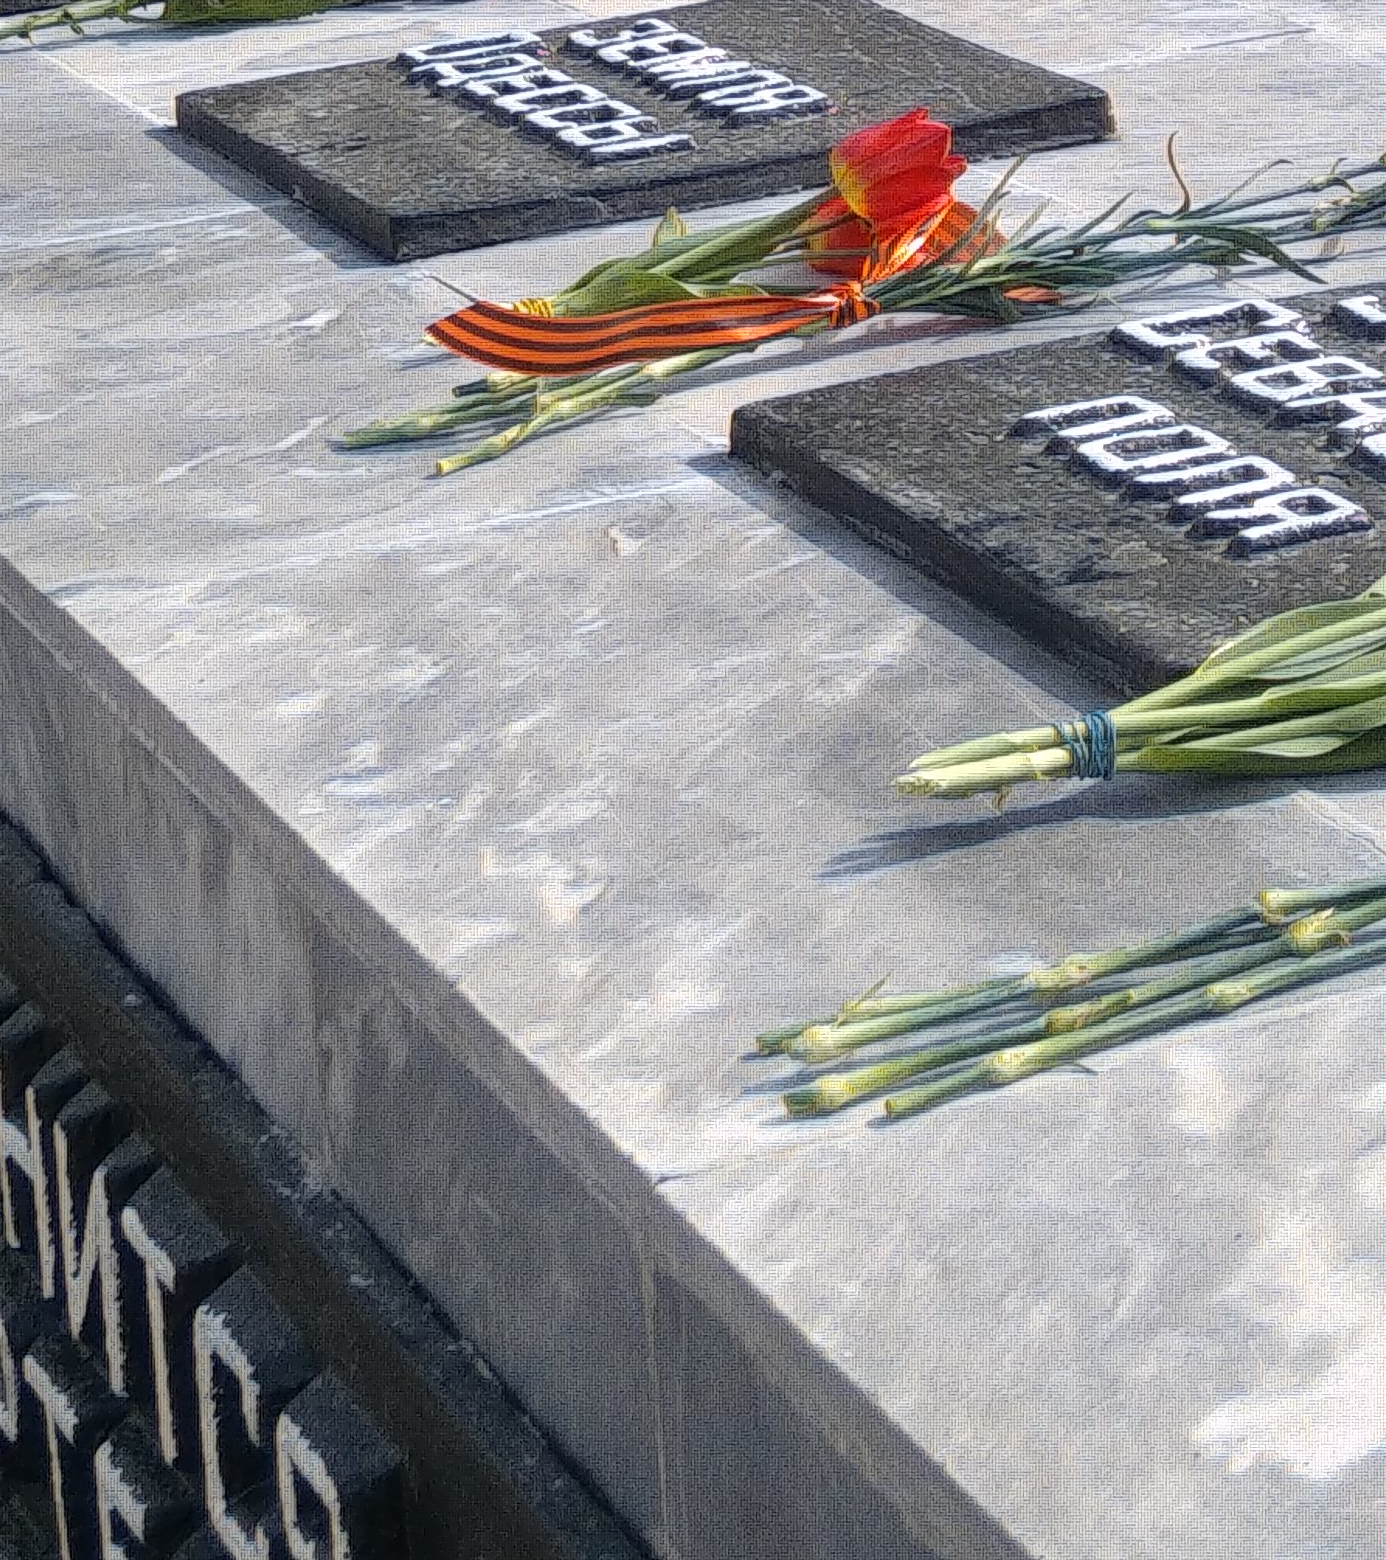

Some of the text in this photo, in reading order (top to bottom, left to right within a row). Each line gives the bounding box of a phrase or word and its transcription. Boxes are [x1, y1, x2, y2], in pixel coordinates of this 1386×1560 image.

[402, 31, 696, 153] ОДЕССЫ
[568, 18, 828, 113] ЗЕМЛЯ
[1021, 395, 1373, 542] ПОЛЯ
